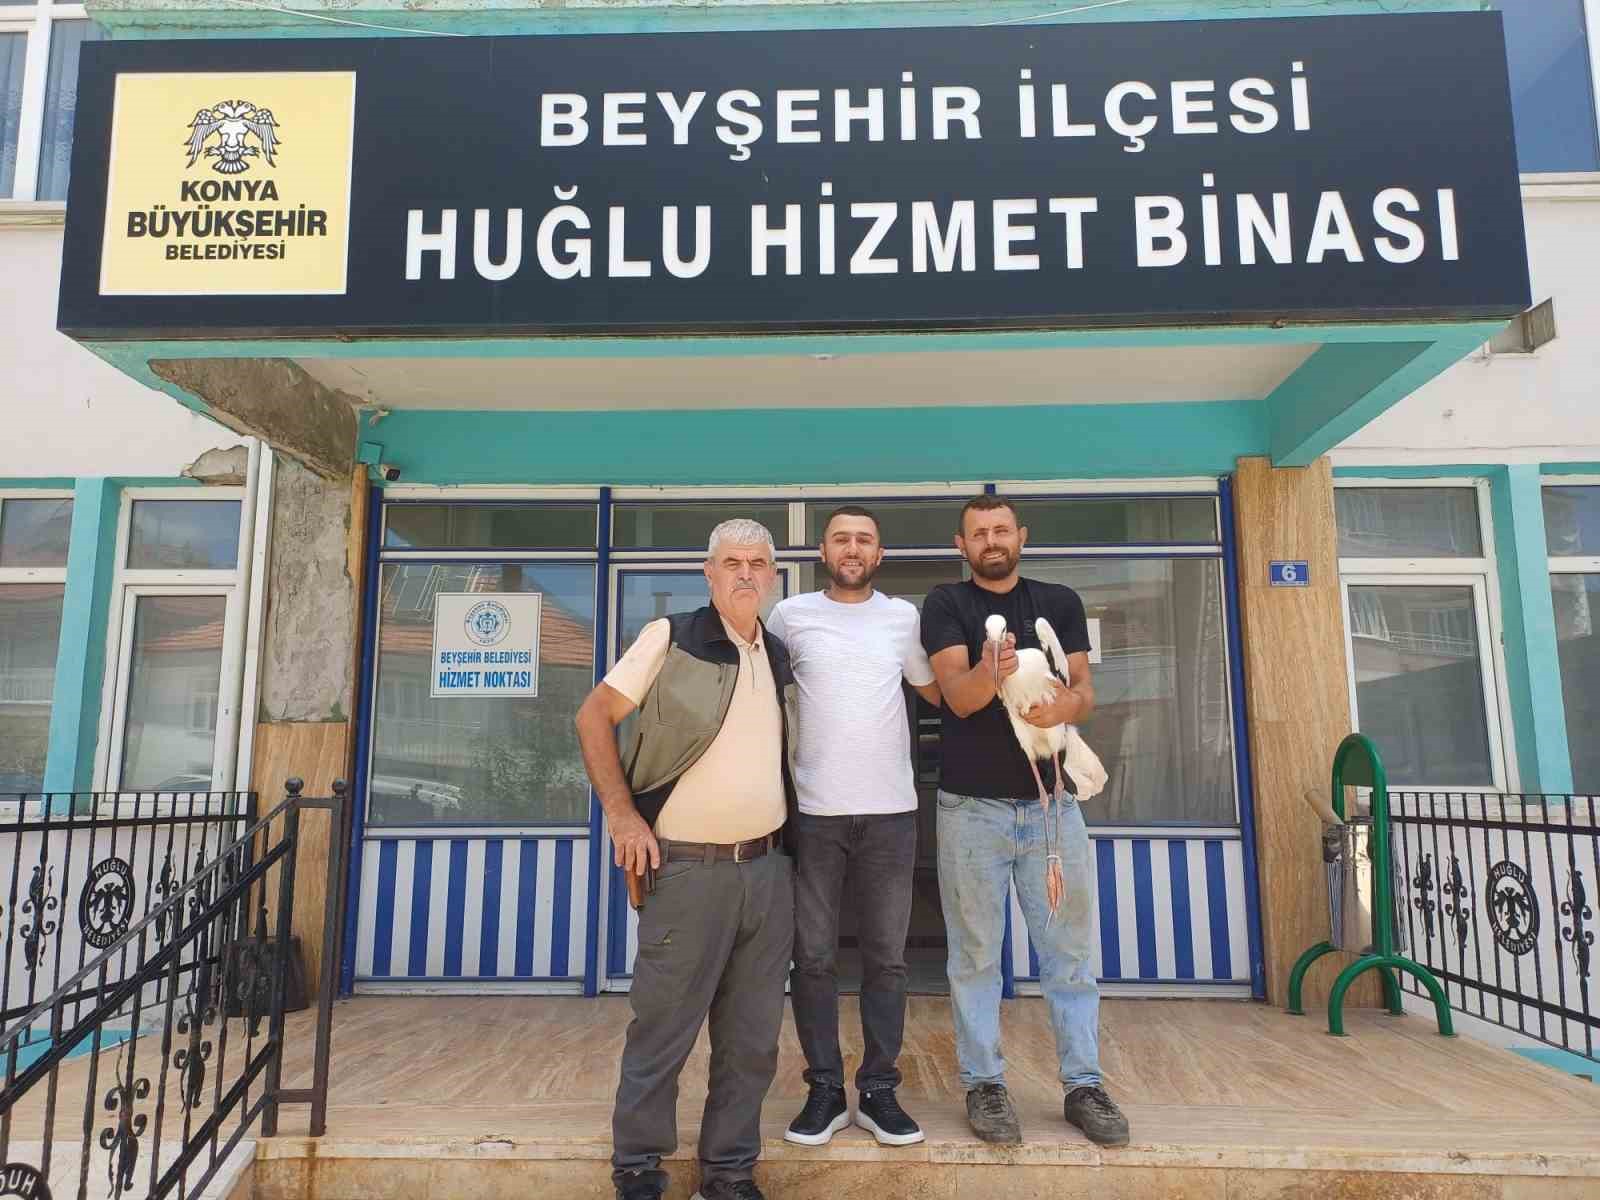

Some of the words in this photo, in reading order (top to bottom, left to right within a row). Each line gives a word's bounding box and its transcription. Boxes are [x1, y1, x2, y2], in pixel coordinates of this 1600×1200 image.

[540, 71, 983, 162] BEYŞEHİR
[1018, 60, 1311, 153] İLÇESİ
[181, 180, 279, 202] KONYA
[127, 203, 328, 242] BÜYÜKŞEHİR
[405, 185, 712, 281] HUĞLU
[751, 181, 1098, 276] HİZMET
[1134, 172, 1459, 268] BİNASI
[165, 239, 286, 260] BELEDİYESİ
[1281, 565, 1297, 581] 6
[440, 649, 481, 666] BEYŞEHİR
[483, 648, 531, 664] BELEDİYESİ
[439, 666, 480, 688] HİZMET
[484, 671, 531, 688] NOKTASI
